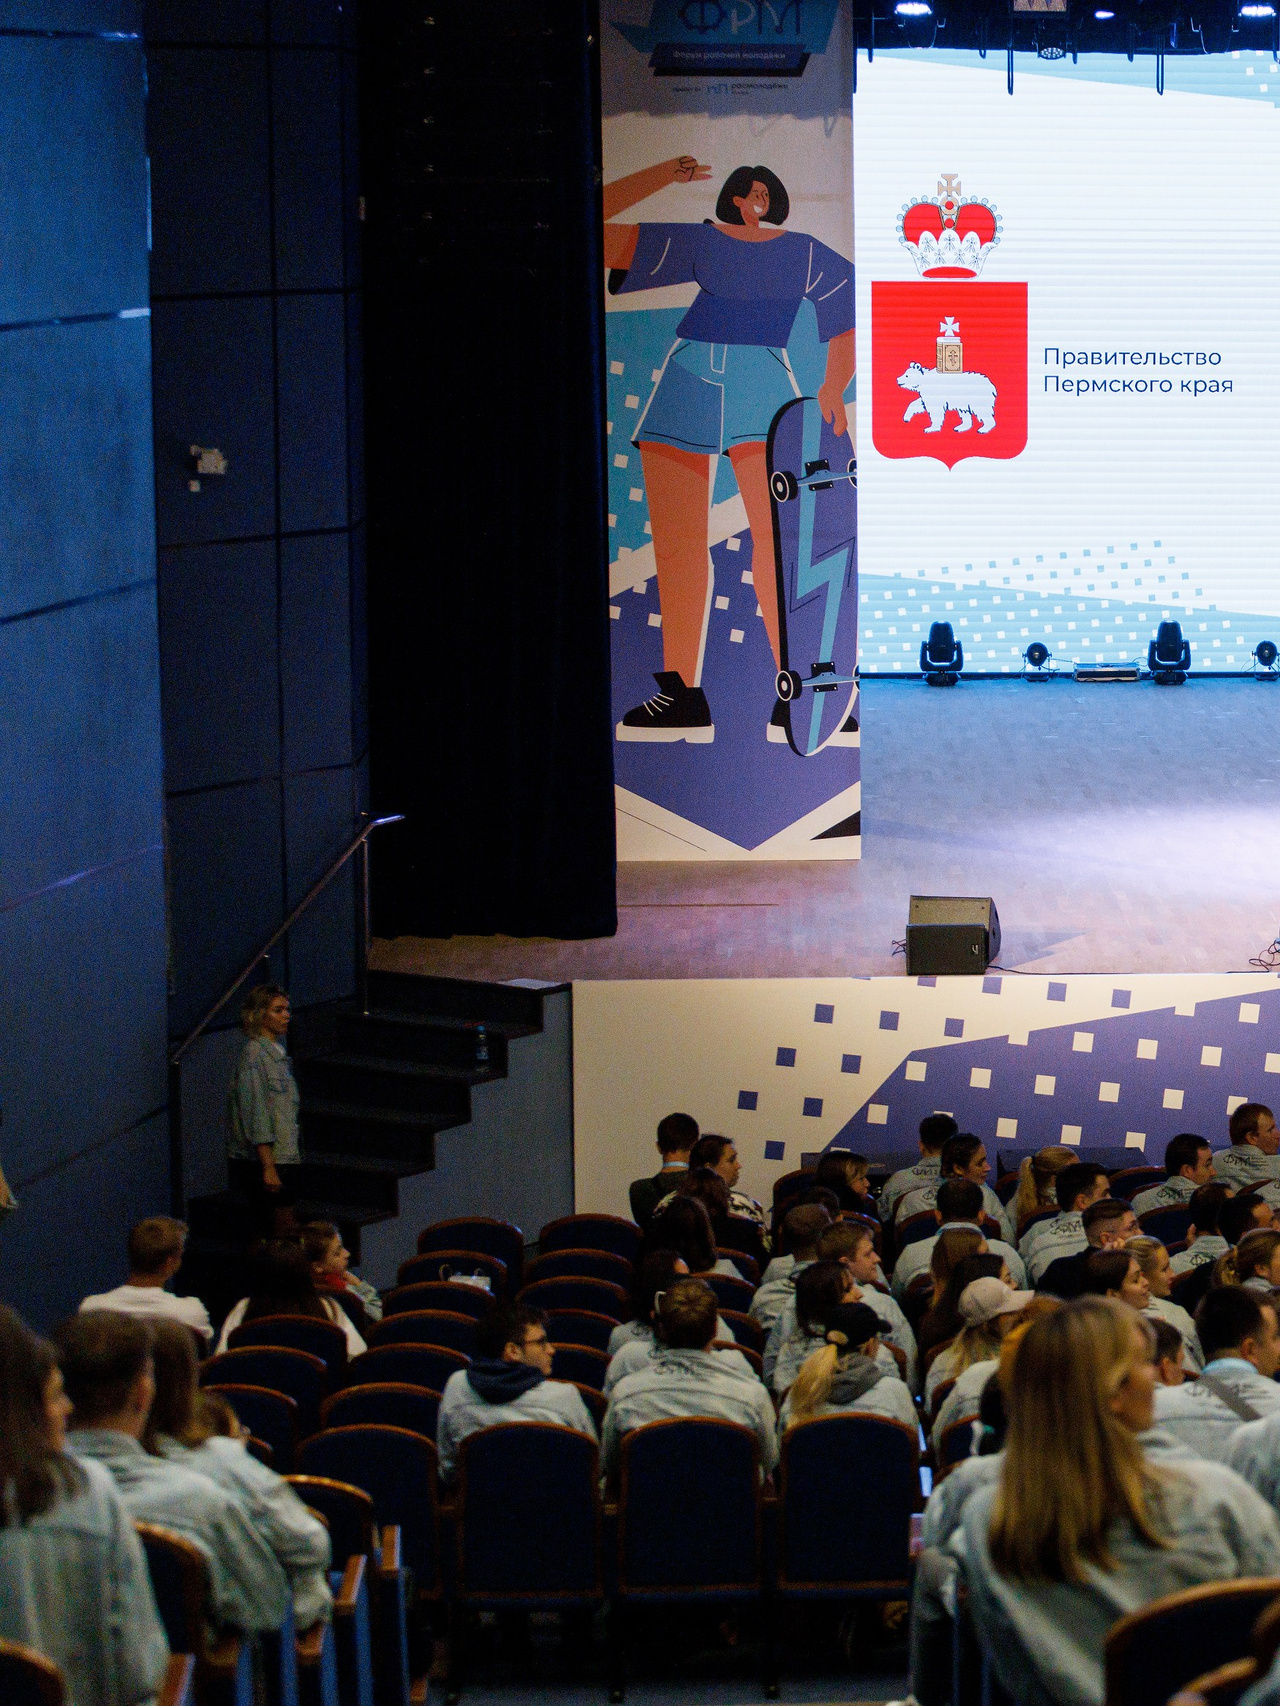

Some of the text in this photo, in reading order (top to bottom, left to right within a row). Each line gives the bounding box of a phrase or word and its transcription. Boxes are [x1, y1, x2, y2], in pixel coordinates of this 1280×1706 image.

[1044, 347, 1222, 369] Правительство
[1044, 375, 1233, 397] Пермского края
